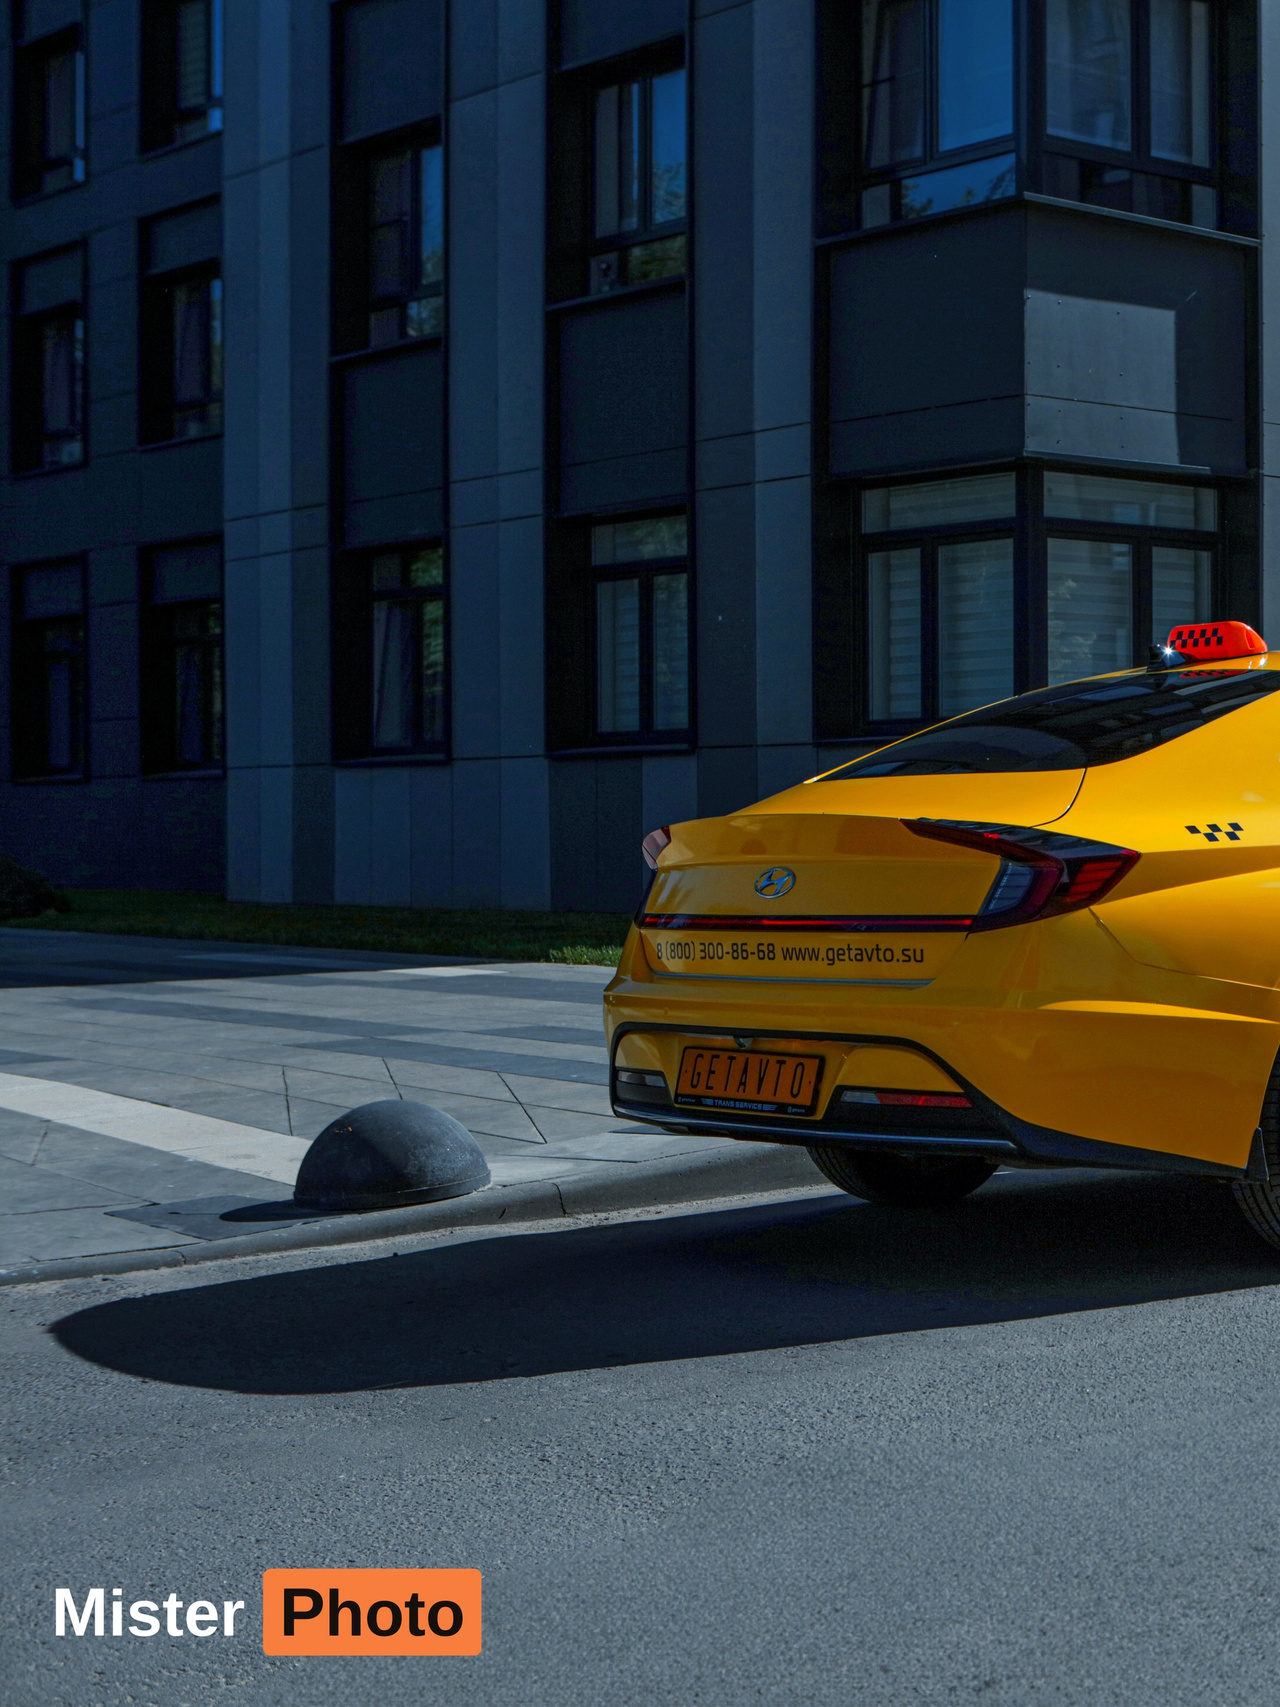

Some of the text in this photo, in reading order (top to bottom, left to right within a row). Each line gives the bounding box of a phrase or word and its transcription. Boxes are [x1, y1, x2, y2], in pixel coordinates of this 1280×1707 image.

[656, 940, 925, 966] 8 (800) 300-86-68 www.getavto.su
[690, 1053, 805, 1098] GETAVTO
[714, 1099, 763, 1110] TRANS SERVICE
